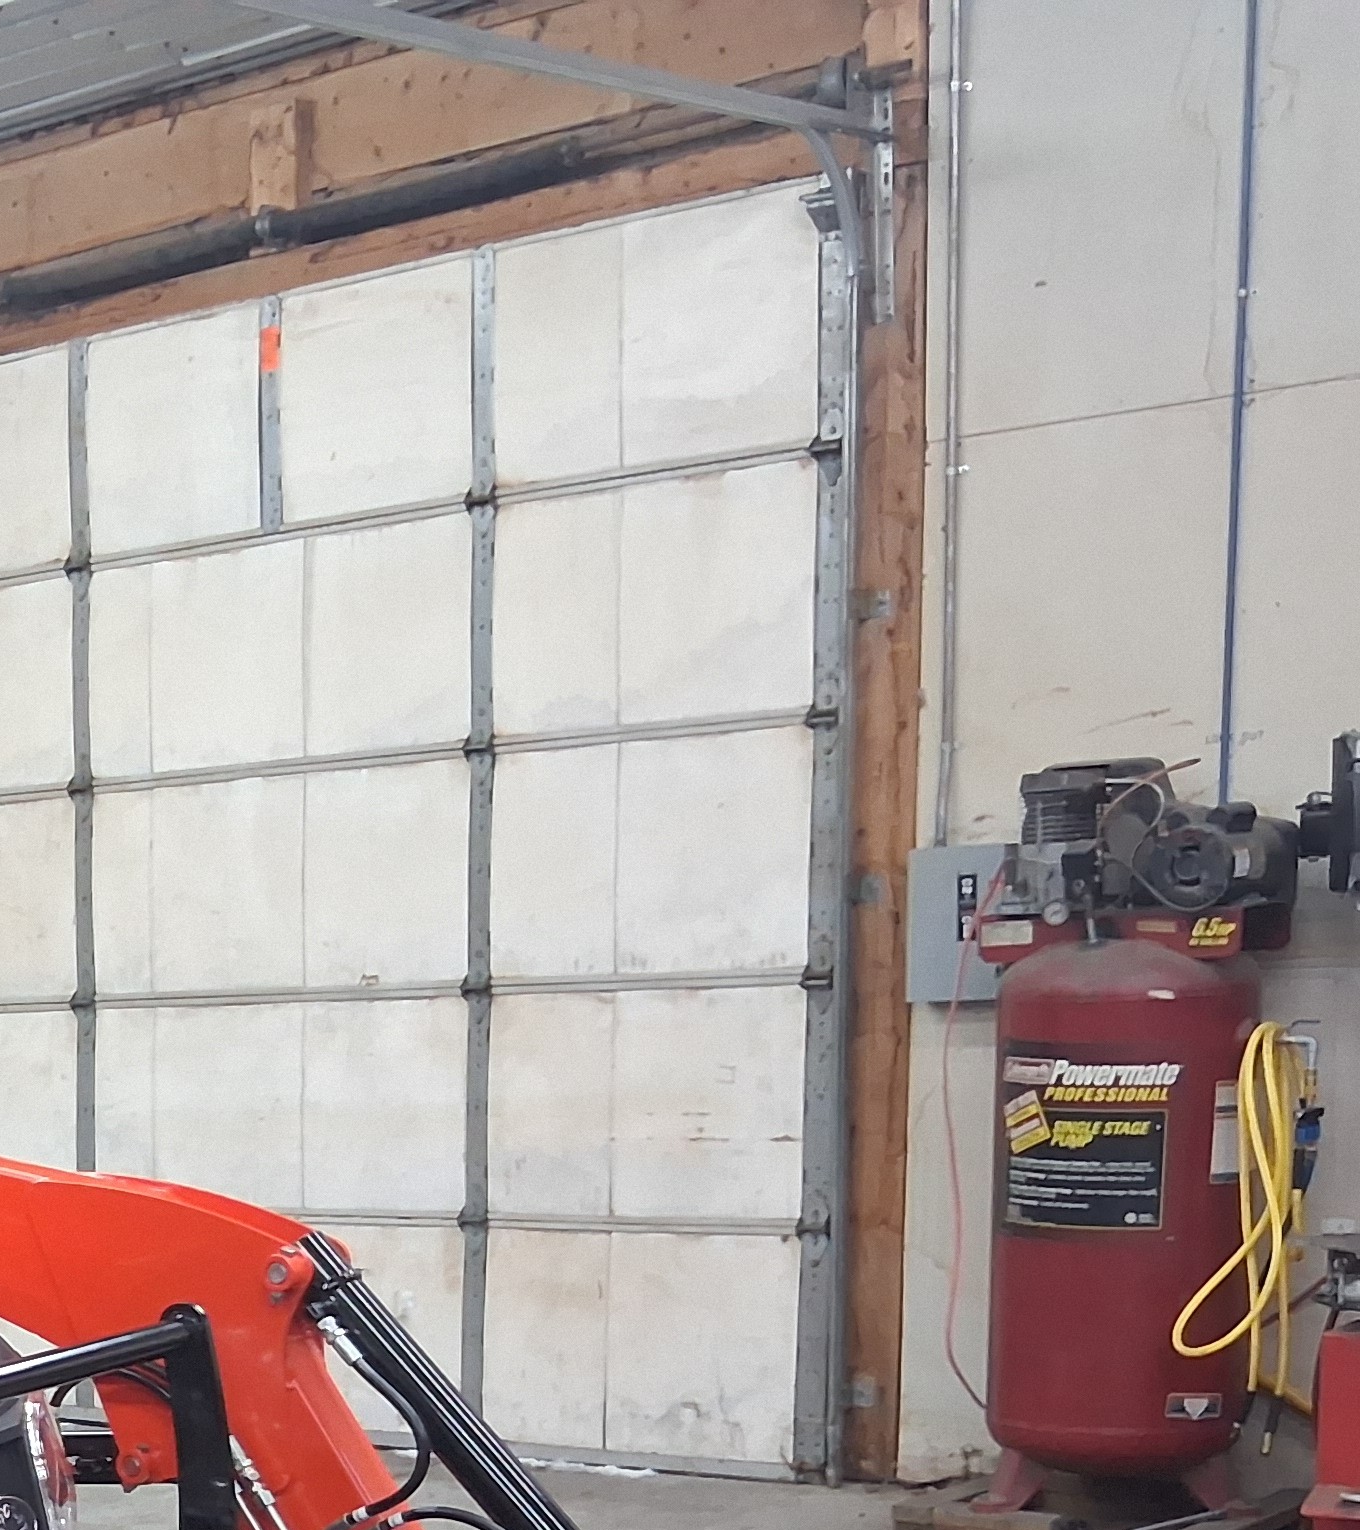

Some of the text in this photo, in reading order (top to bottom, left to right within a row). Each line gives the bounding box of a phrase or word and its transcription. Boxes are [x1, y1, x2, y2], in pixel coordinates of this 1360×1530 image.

[1048, 1058, 1181, 1086] Powermate
[1043, 1086, 1169, 1102] PROFESSIONAL
[1102, 1120, 1152, 1136] STAGE
